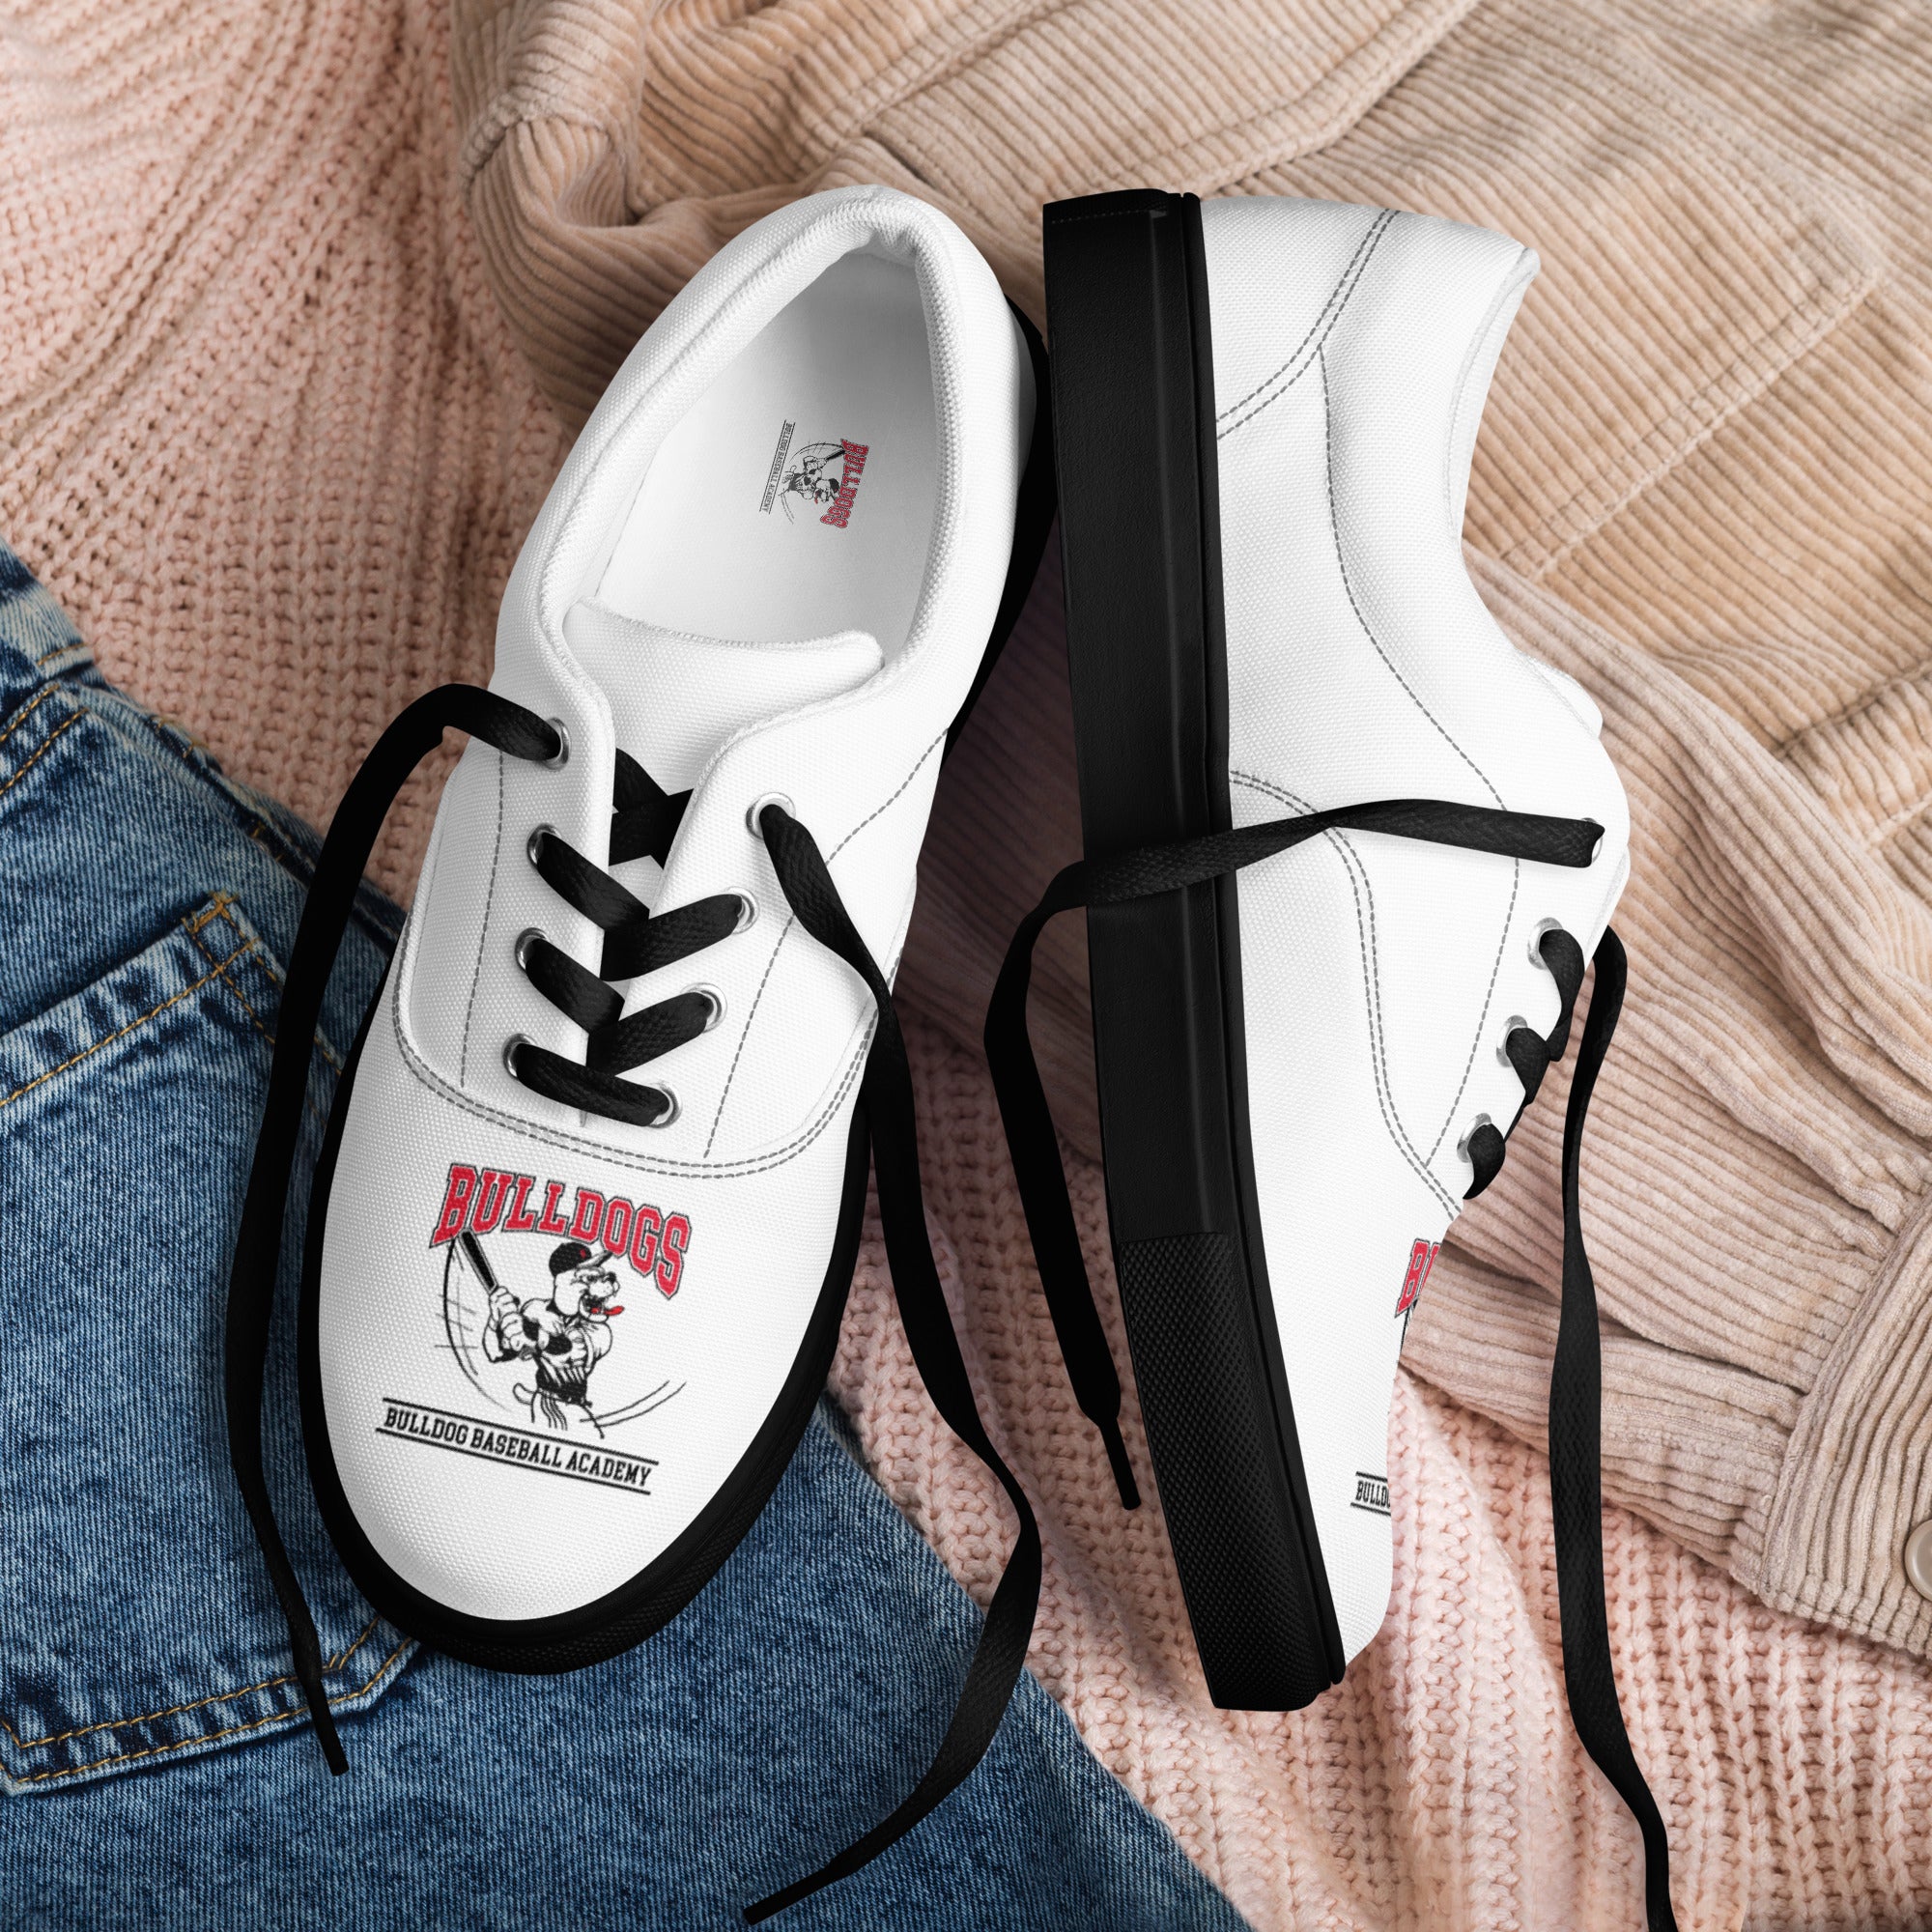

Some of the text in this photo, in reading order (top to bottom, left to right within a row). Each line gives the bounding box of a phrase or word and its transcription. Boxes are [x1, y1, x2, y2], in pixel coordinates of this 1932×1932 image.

[772, 451, 785, 483] BASEBALL
[820, 439, 869, 528] BULLDOGS
[430, 1163, 692, 1299] BULLDOGS
[384, 1407, 652, 1488] BULLDOG BASEBALL ACADEMY
